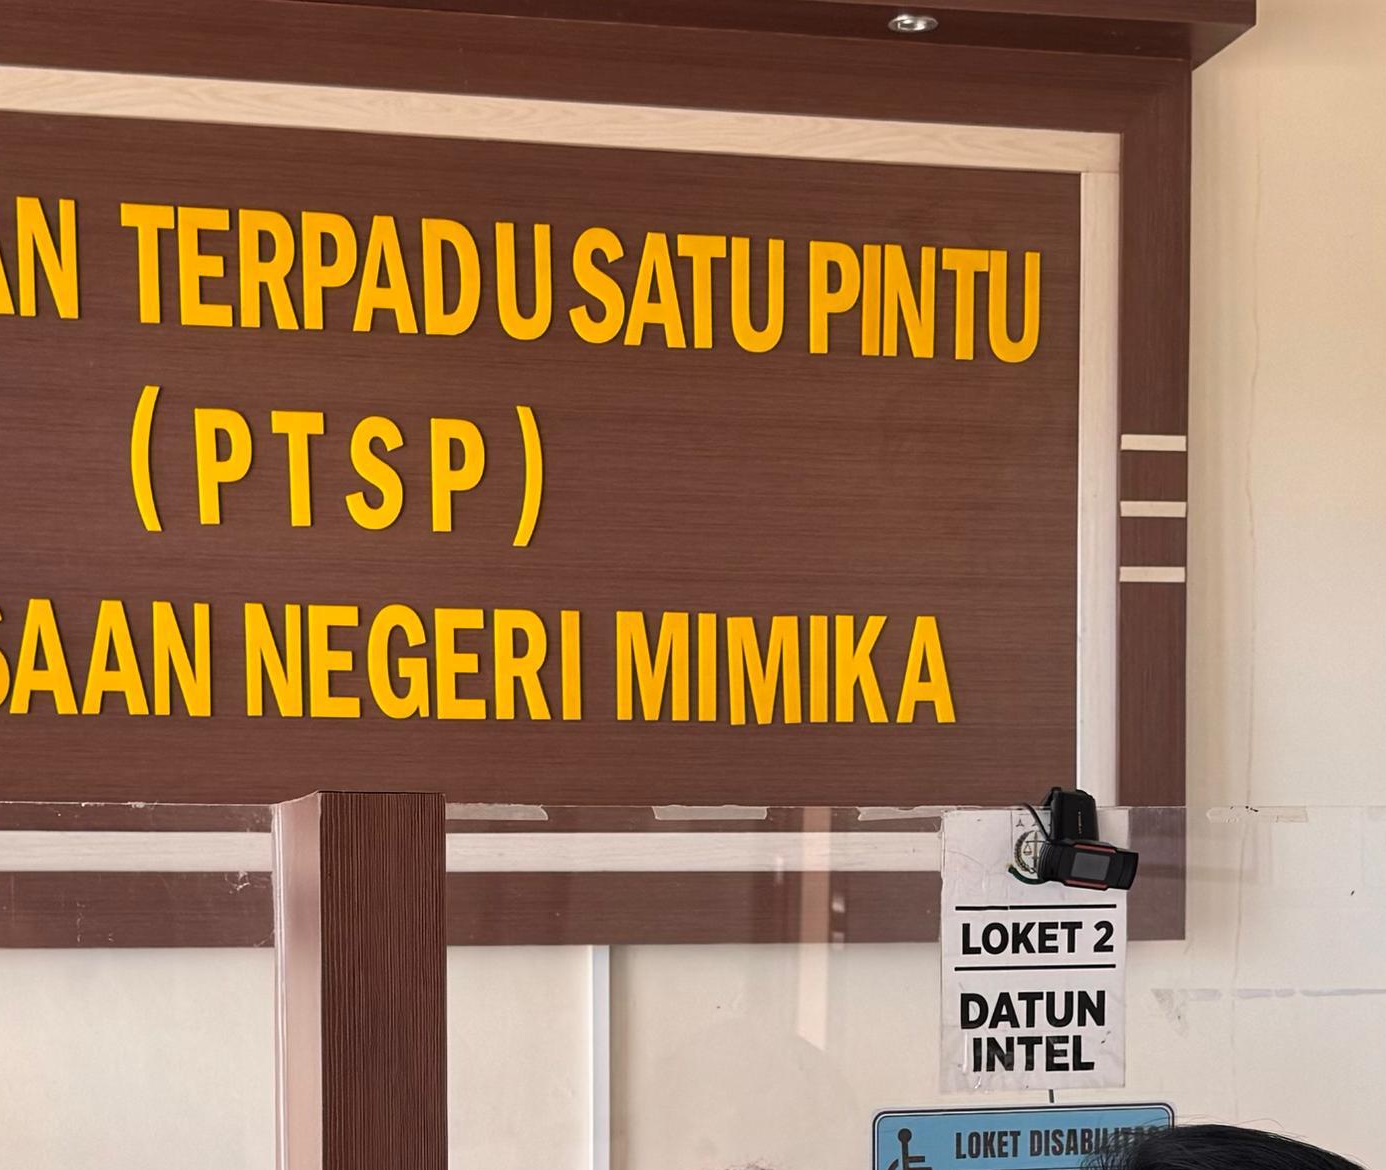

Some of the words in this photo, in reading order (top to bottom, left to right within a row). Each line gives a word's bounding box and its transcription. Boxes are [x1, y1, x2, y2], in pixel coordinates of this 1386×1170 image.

[120, 203, 554, 341] TERPADU
[569, 227, 785, 353] SATU
[809, 240, 1041, 363] PINTU
[244, 603, 582, 722] NEGERI
[615, 611, 957, 726] MIMIKA
[961, 920, 1082, 955] LOKET
[1093, 920, 1114, 953] 2
[960, 990, 1106, 1030] DATUN
[972, 1034, 1095, 1073] INTEL
[955, 1130, 1021, 1160] LOKET
[1029, 1126, 1165, 1158] DISABIL
